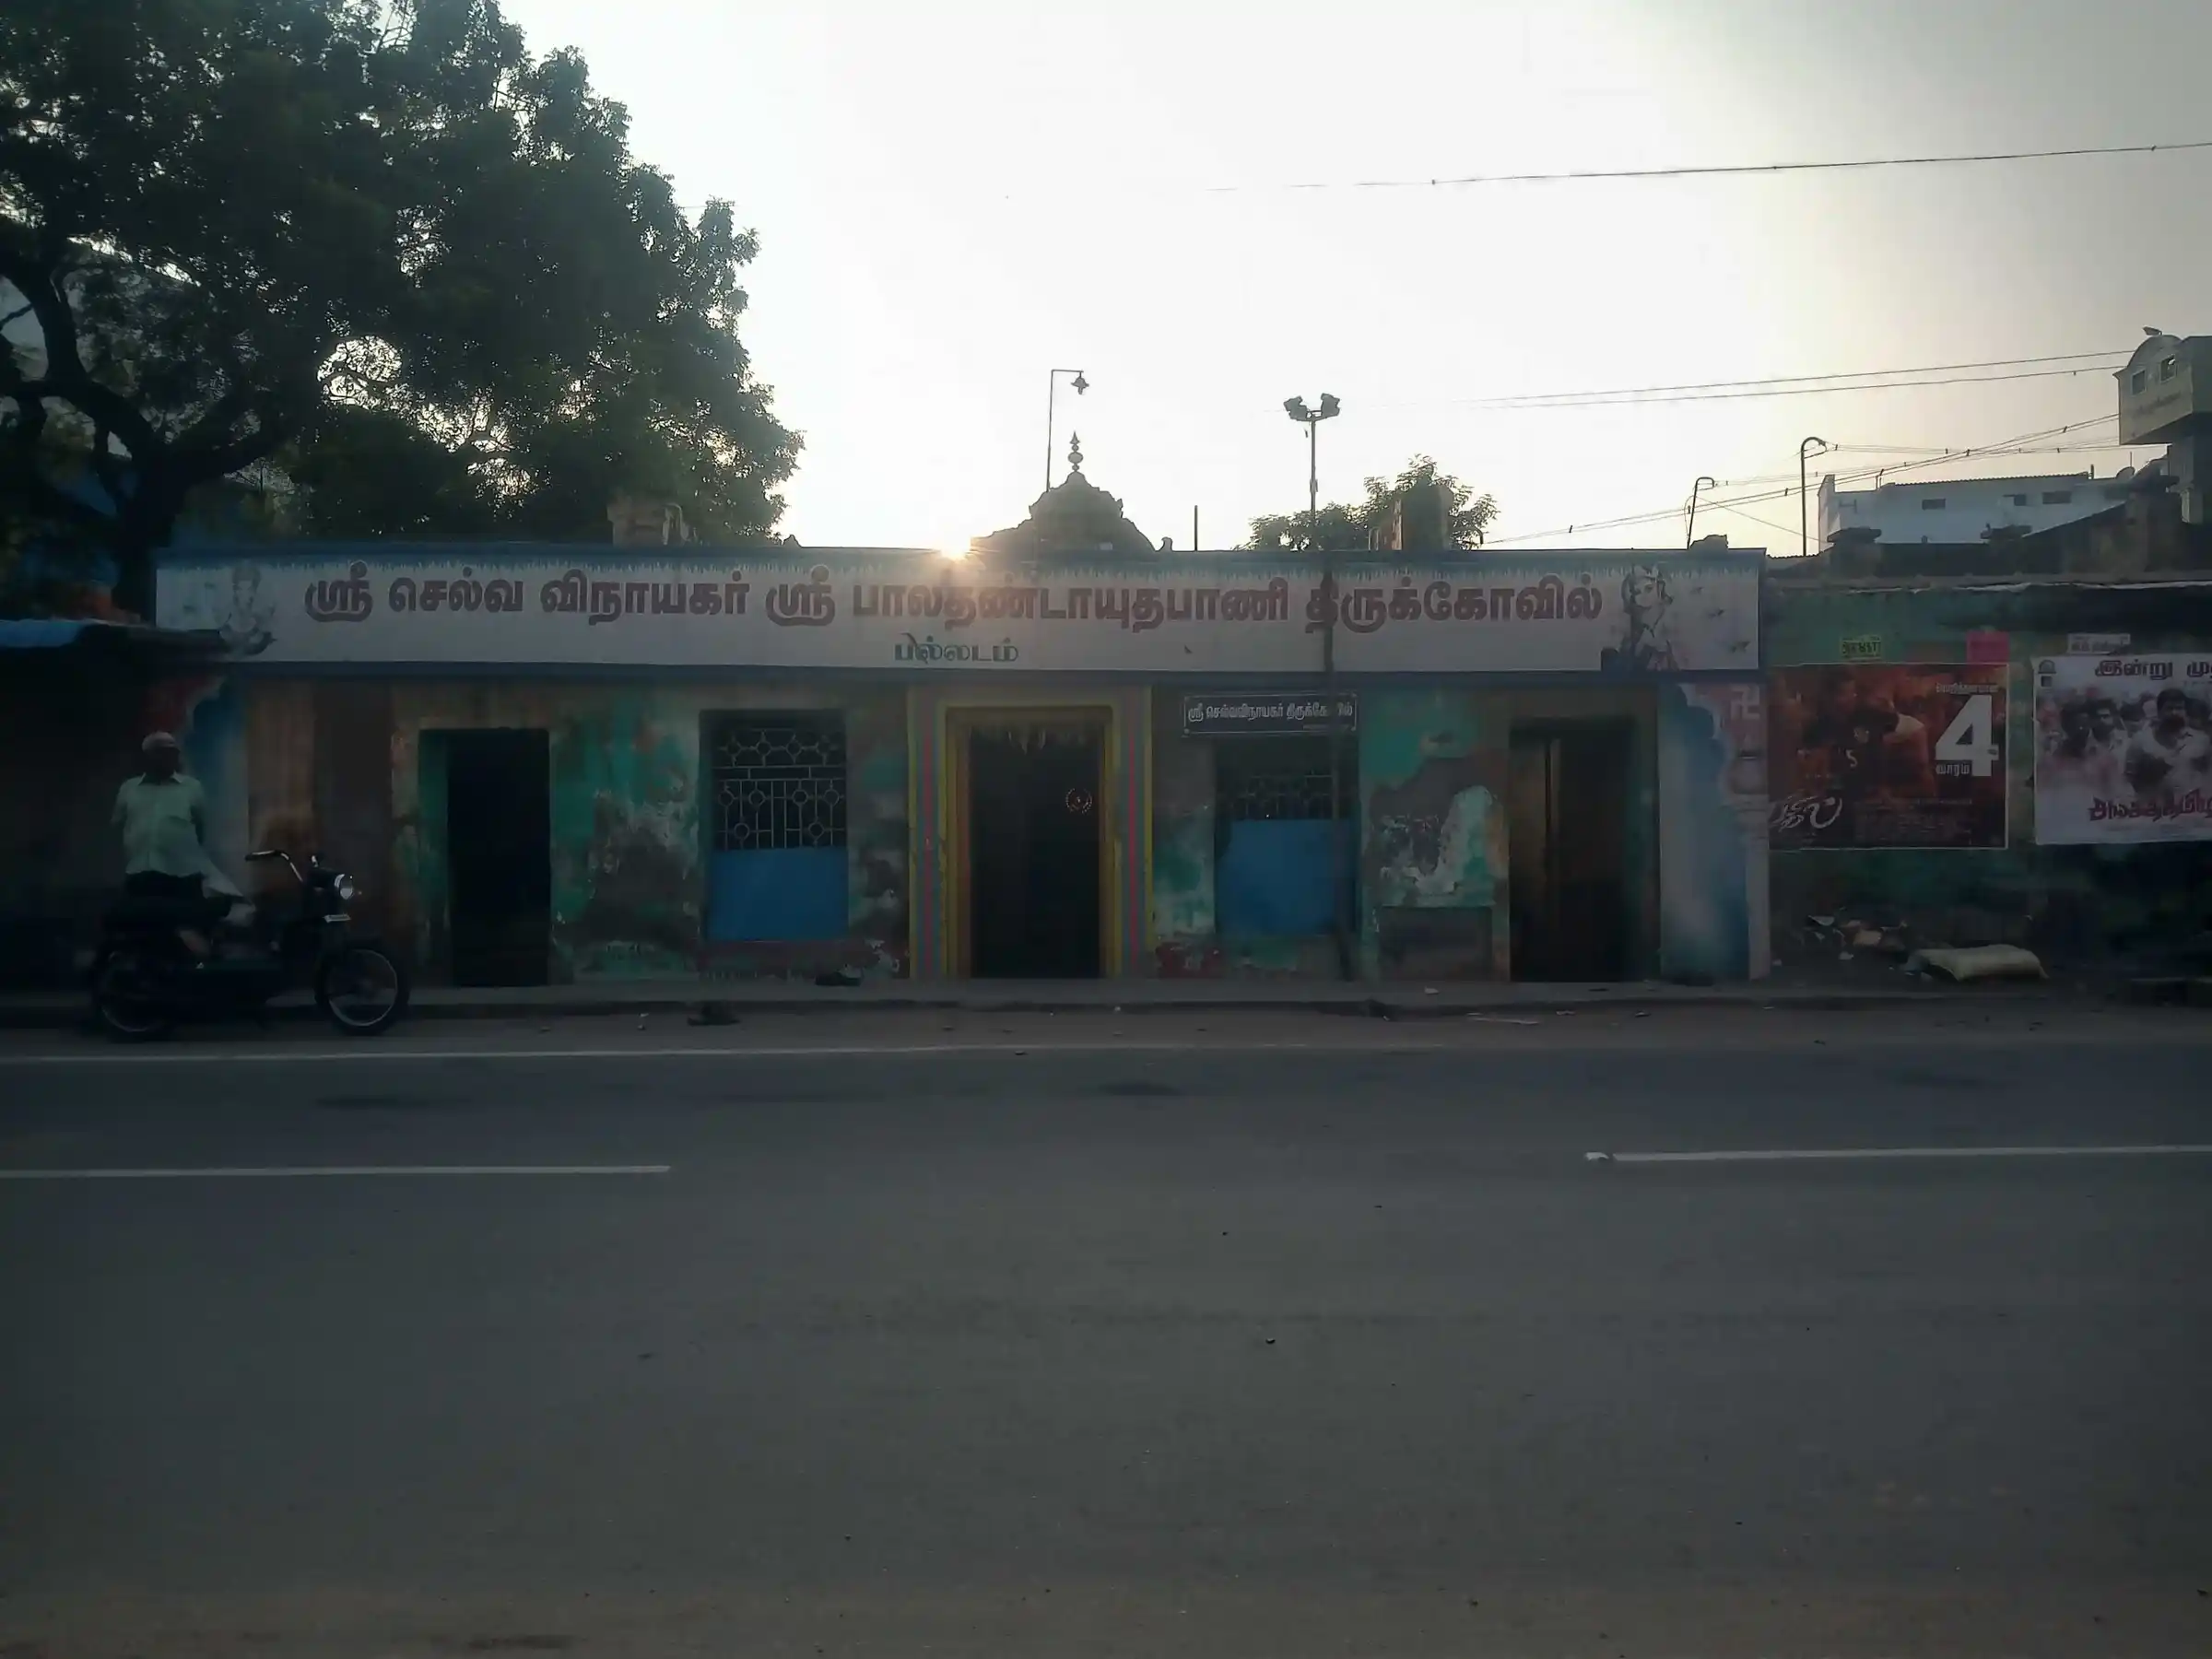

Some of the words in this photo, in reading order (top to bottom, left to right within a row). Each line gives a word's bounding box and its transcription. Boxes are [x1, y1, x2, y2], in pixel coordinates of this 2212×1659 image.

[388, 566, 524, 614] செல்வ
[540, 568, 750, 626] விநாயகர்
[853, 571, 1288, 633] பாலதண்டாயுதபாணி
[1305, 572, 1603, 633] திருக்கோவில்
[2095, 659, 2172, 680] இன்று
[1936, 694, 1999, 776] 4
